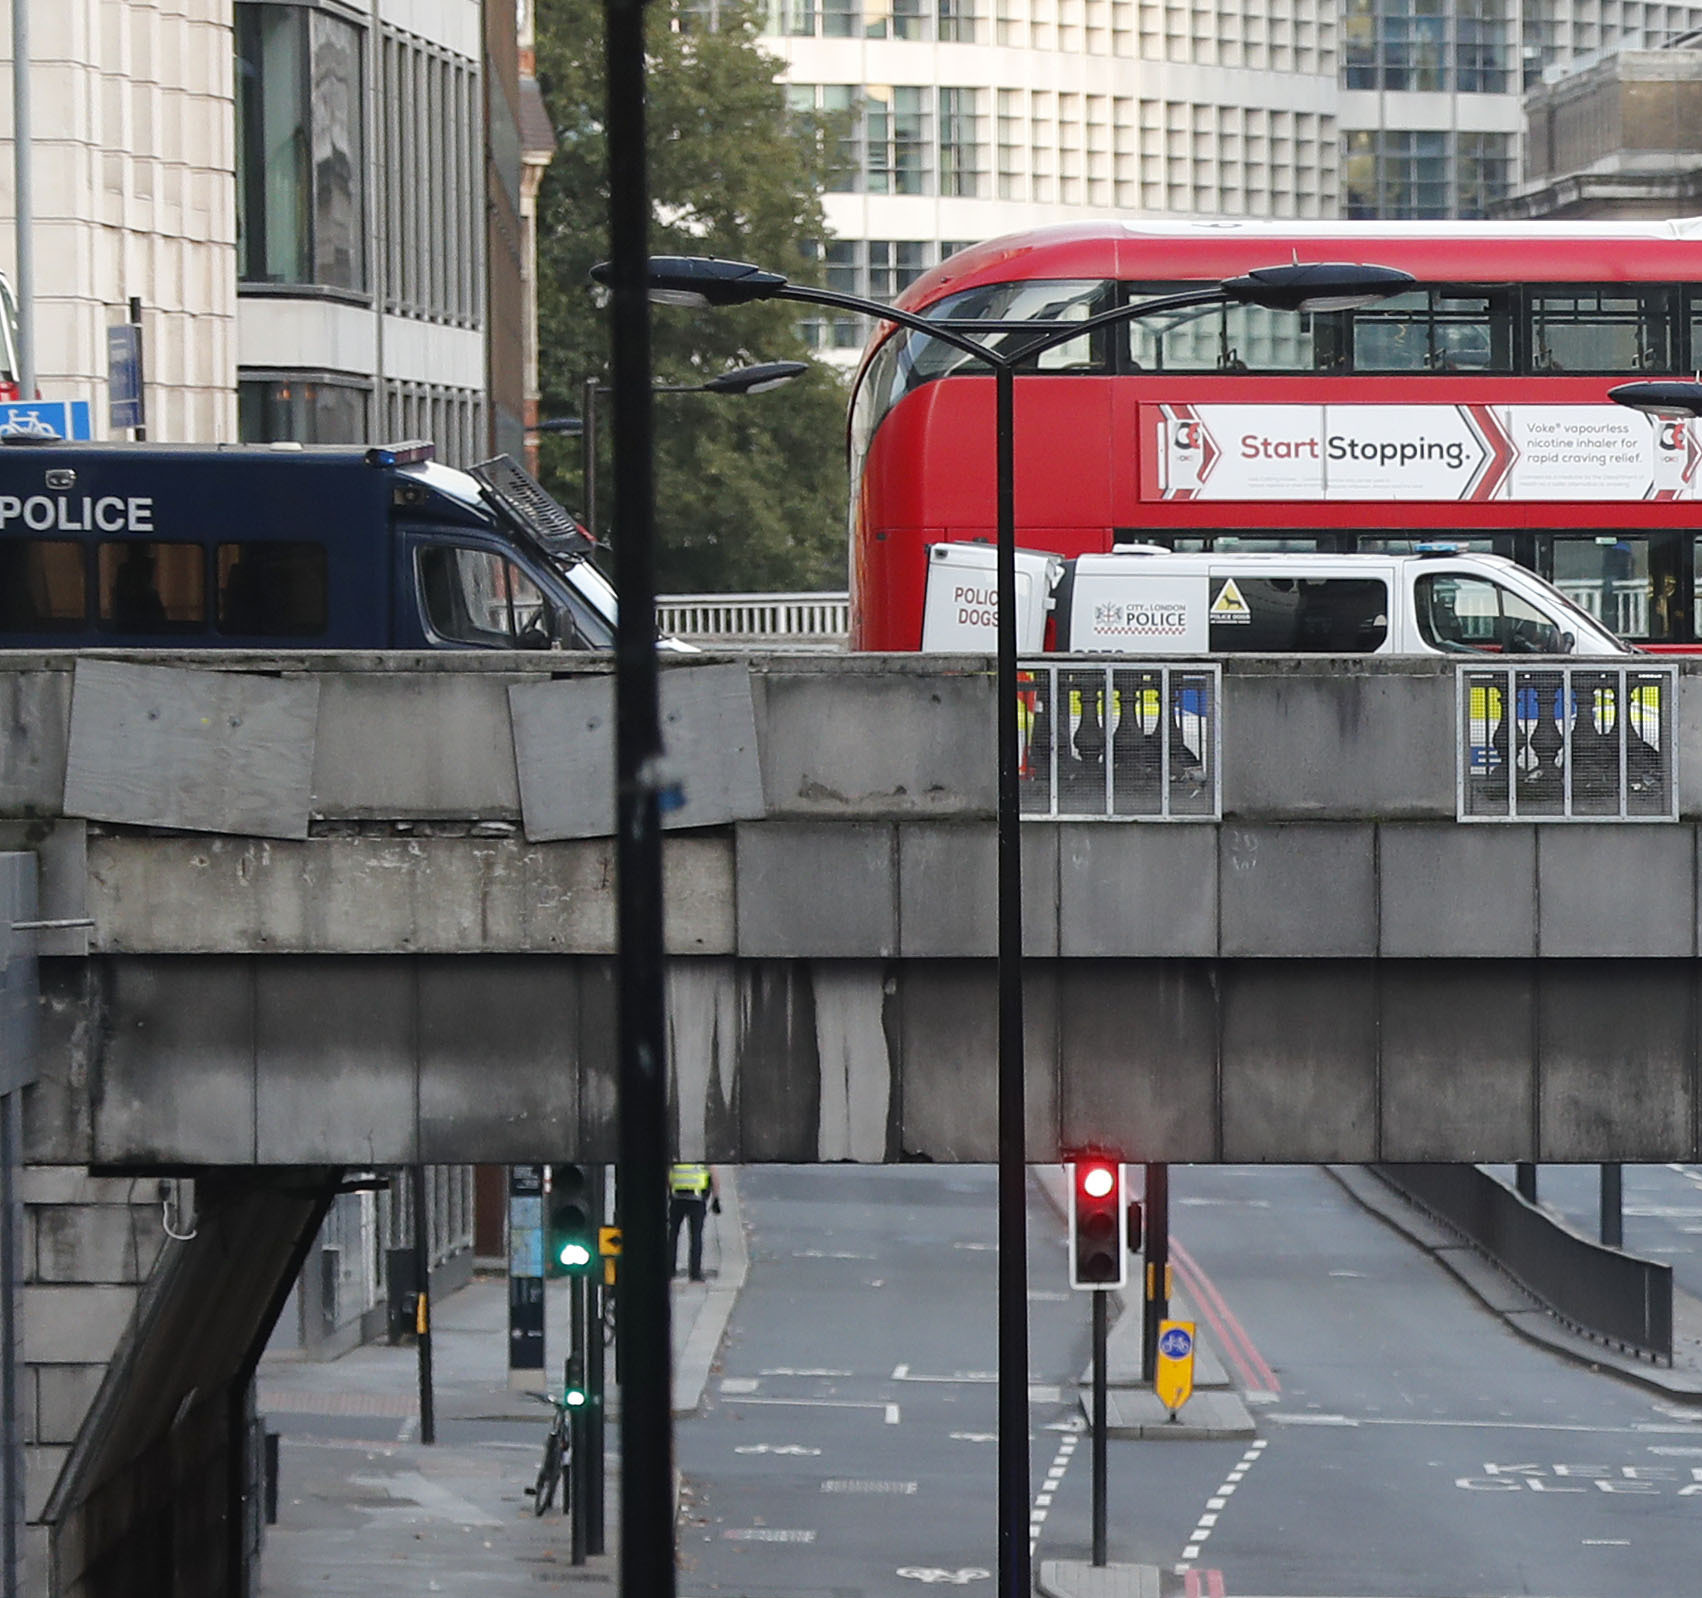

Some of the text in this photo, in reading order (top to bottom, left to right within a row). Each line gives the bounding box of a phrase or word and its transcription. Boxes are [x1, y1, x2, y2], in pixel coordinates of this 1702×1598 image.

[1564, 423, 1630, 435] vapourless
[1527, 438, 1638, 449] nicotine inhaler for
[1241, 435, 1471, 469] Start Stopping.
[1527, 453, 1643, 466] rapid craving relief.
[0, 496, 154, 532] POLICE
[954, 587, 999, 606] POLIC
[1126, 612, 1186, 626] POLICE
